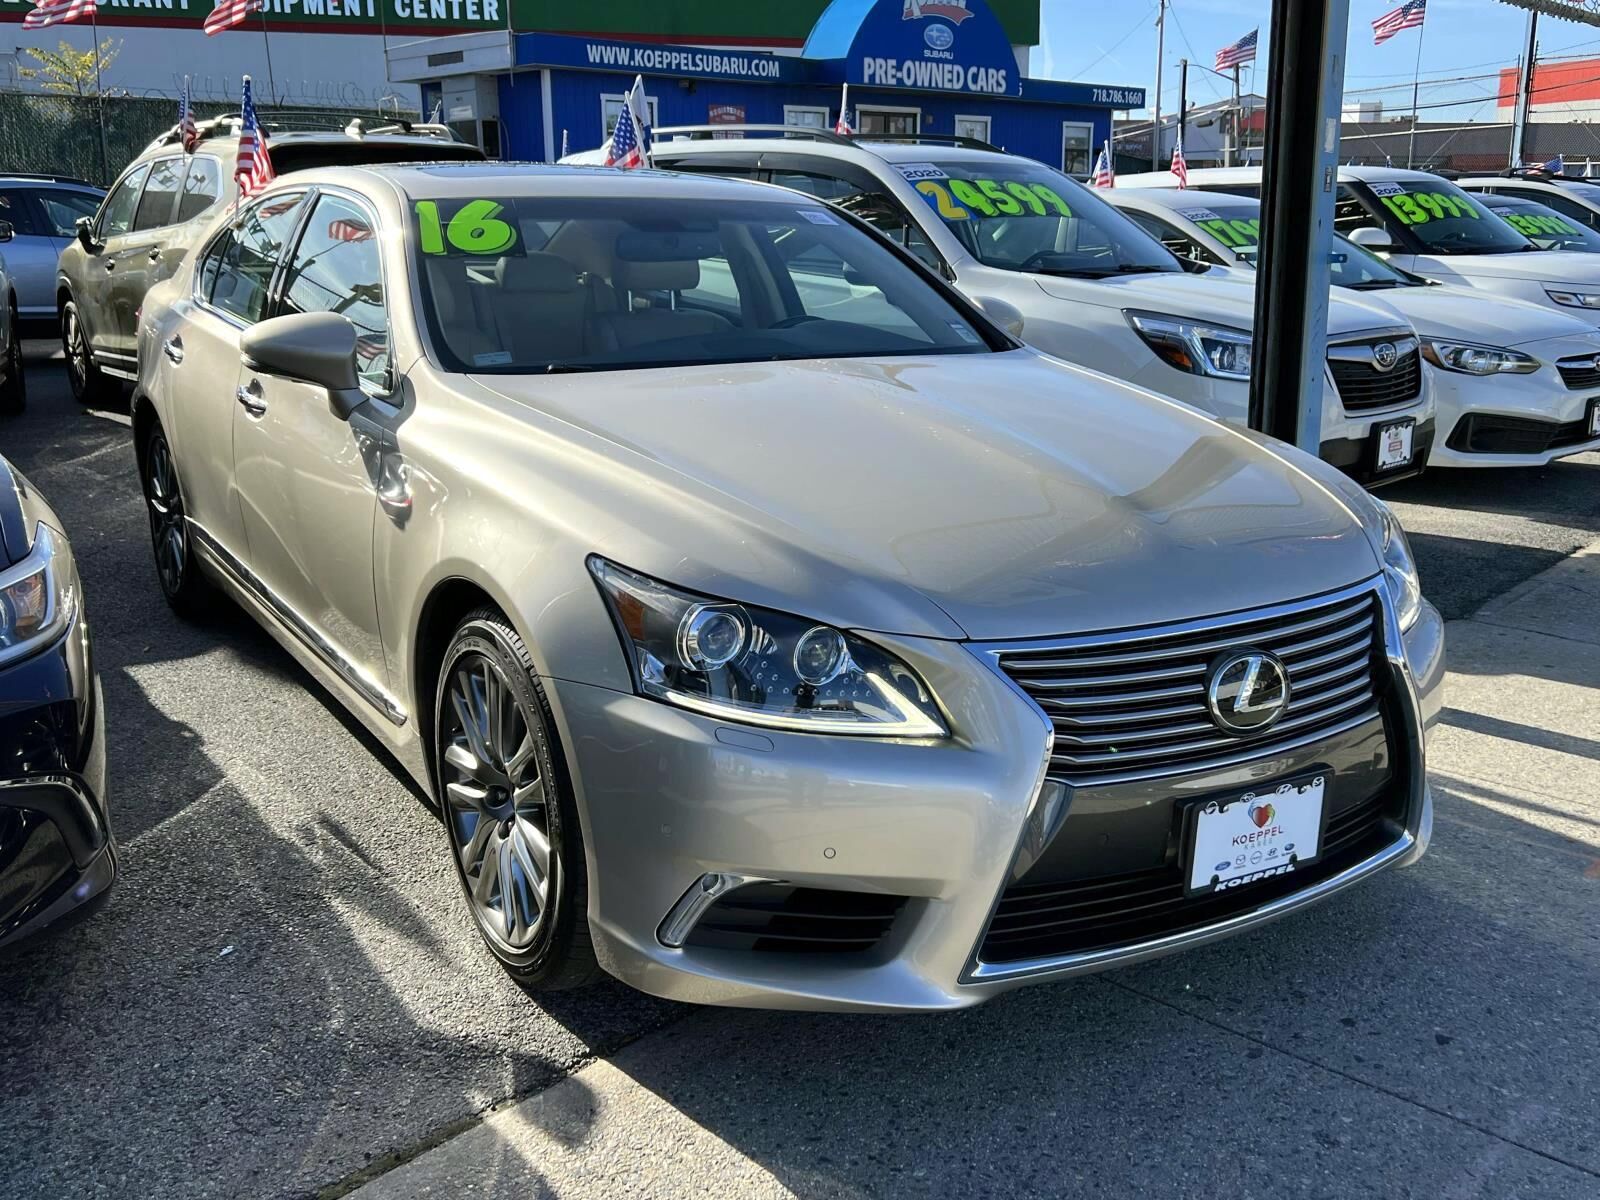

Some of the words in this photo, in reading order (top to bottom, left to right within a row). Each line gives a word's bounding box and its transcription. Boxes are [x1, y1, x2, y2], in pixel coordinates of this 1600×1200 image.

[394, 0, 499, 20] CENTER
[586, 43, 781, 78] WWW.KOEPPELSUBARU.COM
[923, 49, 954, 60] SUBARU
[863, 57, 965, 90] PRE-OWNED
[967, 65, 1007, 93] CARS
[1092, 88, 1143, 105] 718.786.1660
[903, 169, 944, 178] 2020
[914, 179, 1072, 220] 24599
[1375, 187, 1405, 196] 2021
[1380, 191, 1480, 225] 13999
[414, 199, 518, 255] 16
[1232, 825, 1284, 846] KOEPPEL
[1214, 863, 1296, 892] KOEPPEL
